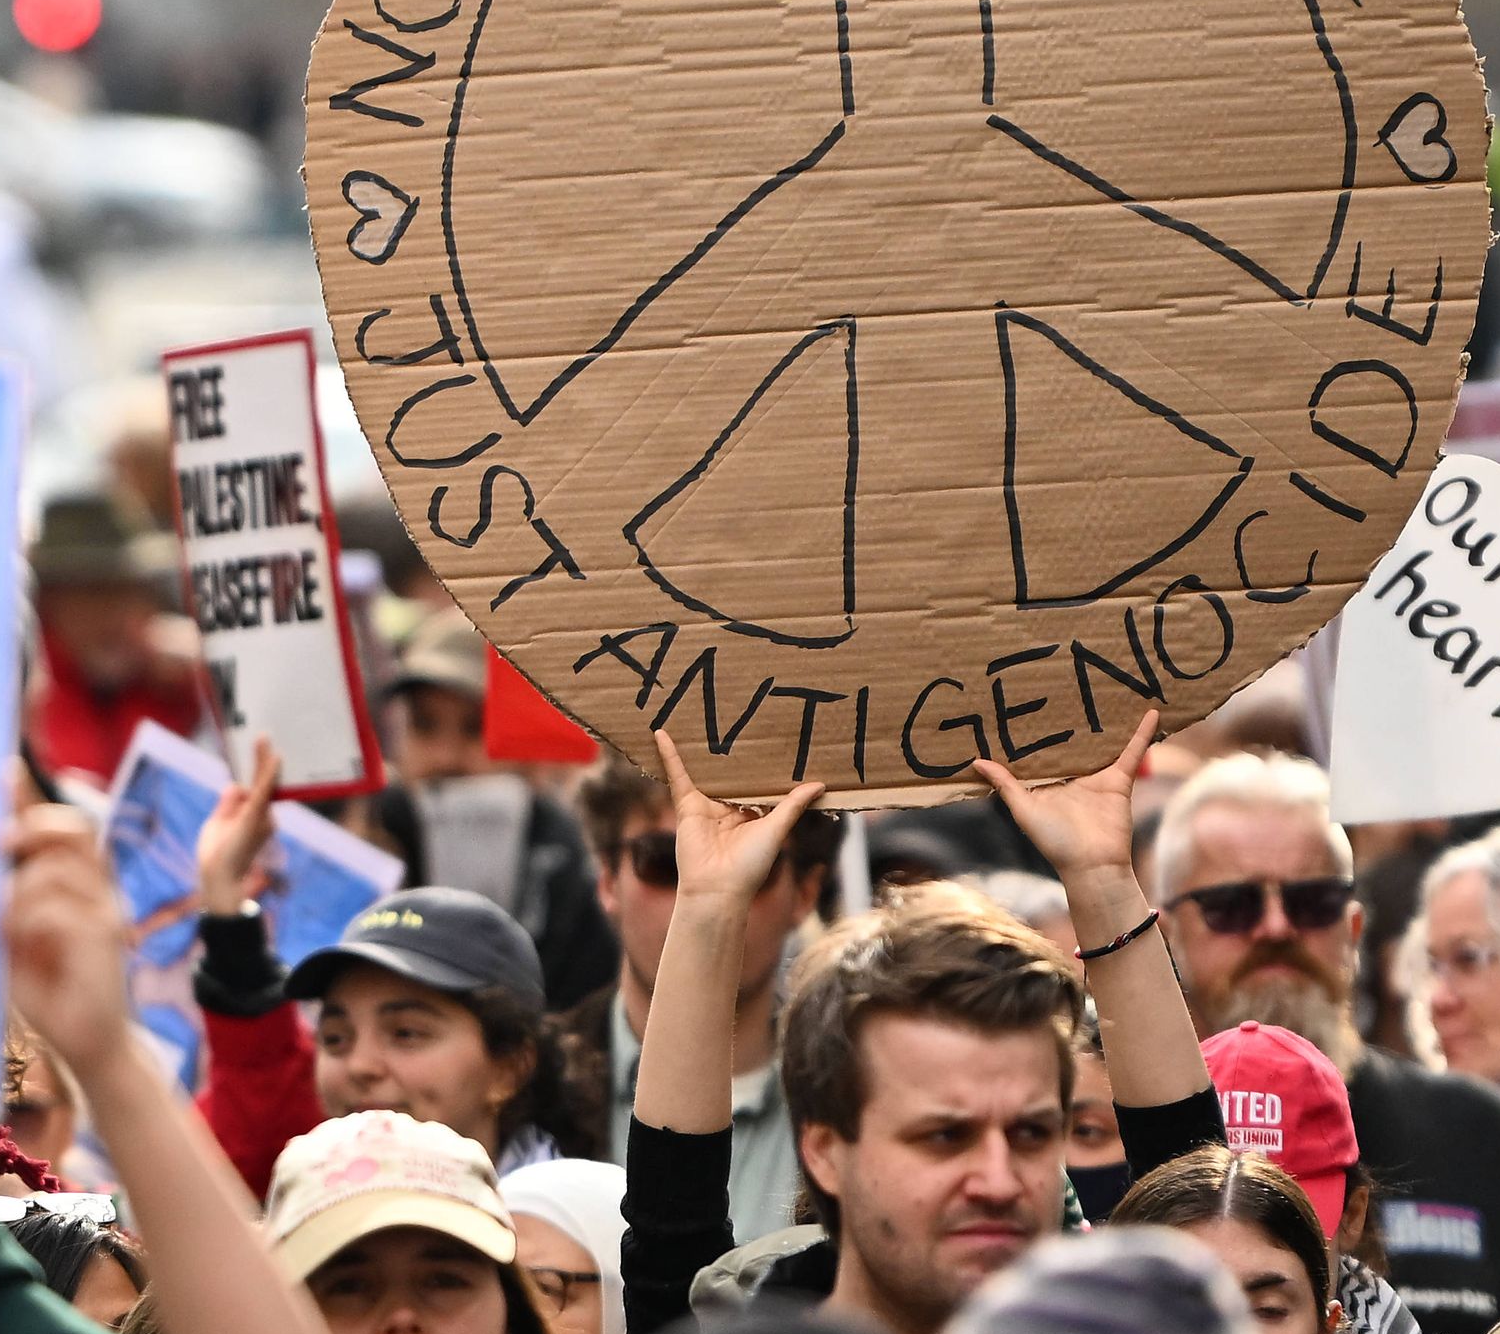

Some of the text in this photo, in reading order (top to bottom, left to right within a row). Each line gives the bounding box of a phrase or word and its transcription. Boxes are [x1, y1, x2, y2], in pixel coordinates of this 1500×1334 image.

[169, 366, 225, 440] FREE
[354, 294, 585, 612] JUST
[190, 549, 322, 633] EASEFIRE
[1243, 1130, 1279, 1146] UNION
